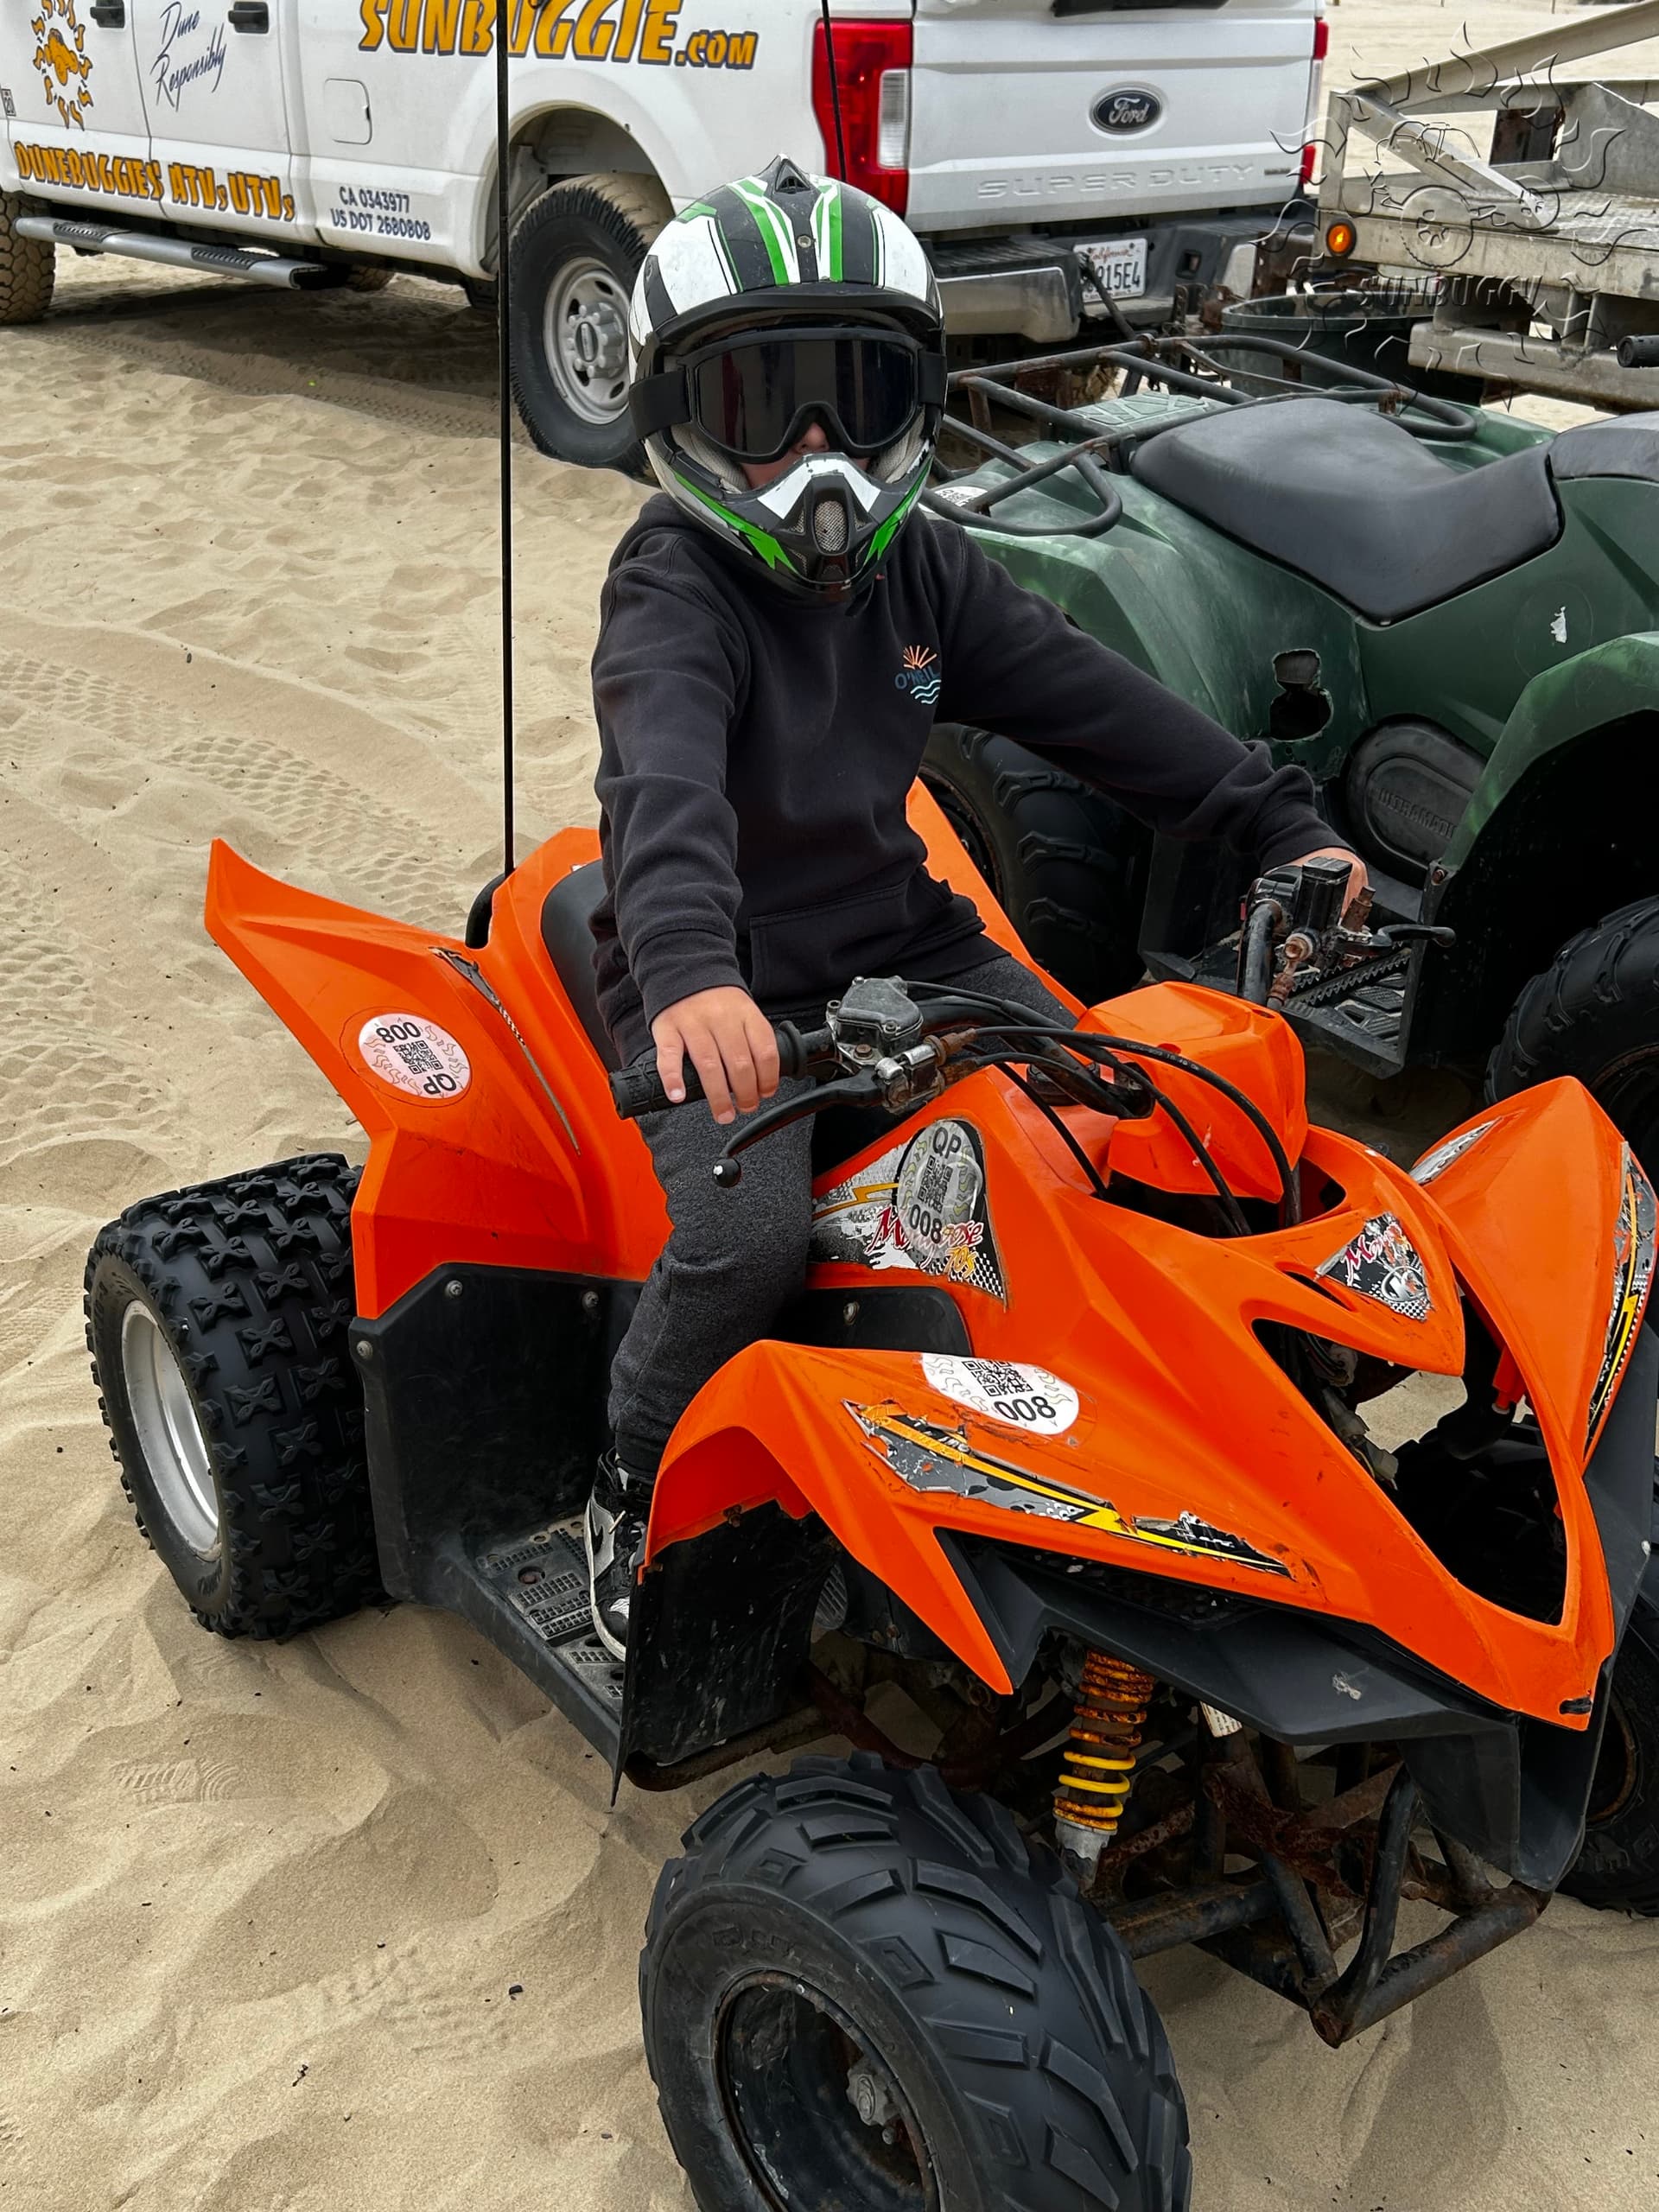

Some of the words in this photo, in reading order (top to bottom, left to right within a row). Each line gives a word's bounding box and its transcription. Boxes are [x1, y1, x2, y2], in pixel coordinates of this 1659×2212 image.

[1109, 97, 1149, 124] Ford
[14, 141, 165, 200] DUNEBUGGIES
[977, 173, 1137, 198] SUPER
[1147, 166, 1254, 187] DUTY
[339, 186, 359, 207] CA
[330, 207, 347, 227] US
[349, 210, 373, 232] DOT
[932, 1127, 962, 1159] QP
[909, 1204, 943, 1244] 008
[994, 1395, 1057, 1421] 008
